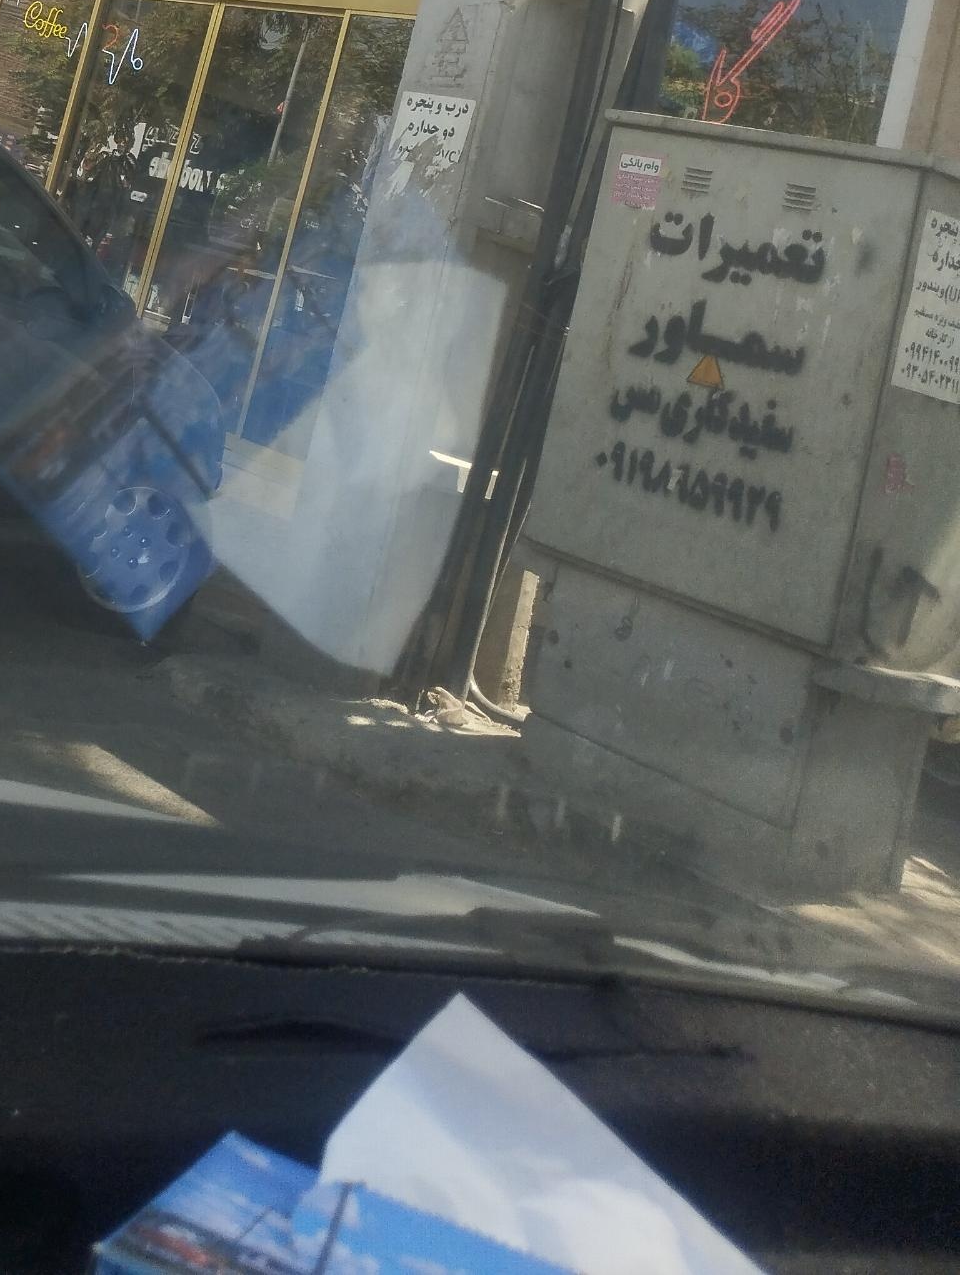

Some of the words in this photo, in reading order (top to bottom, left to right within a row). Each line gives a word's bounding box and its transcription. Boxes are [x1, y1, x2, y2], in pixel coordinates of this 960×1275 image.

[23, 0, 69, 39] Coffee
[406, 96, 434, 114] پنجره
[435, 102, 443, 115] و
[445, 102, 469, 118] درب
[443, 126, 456, 140] دو
[620, 157, 643, 170] بانکی
[644, 160, 660, 173] وام
[650, 211, 827, 285] تعمیرات
[627, 298, 806, 375] سماور
